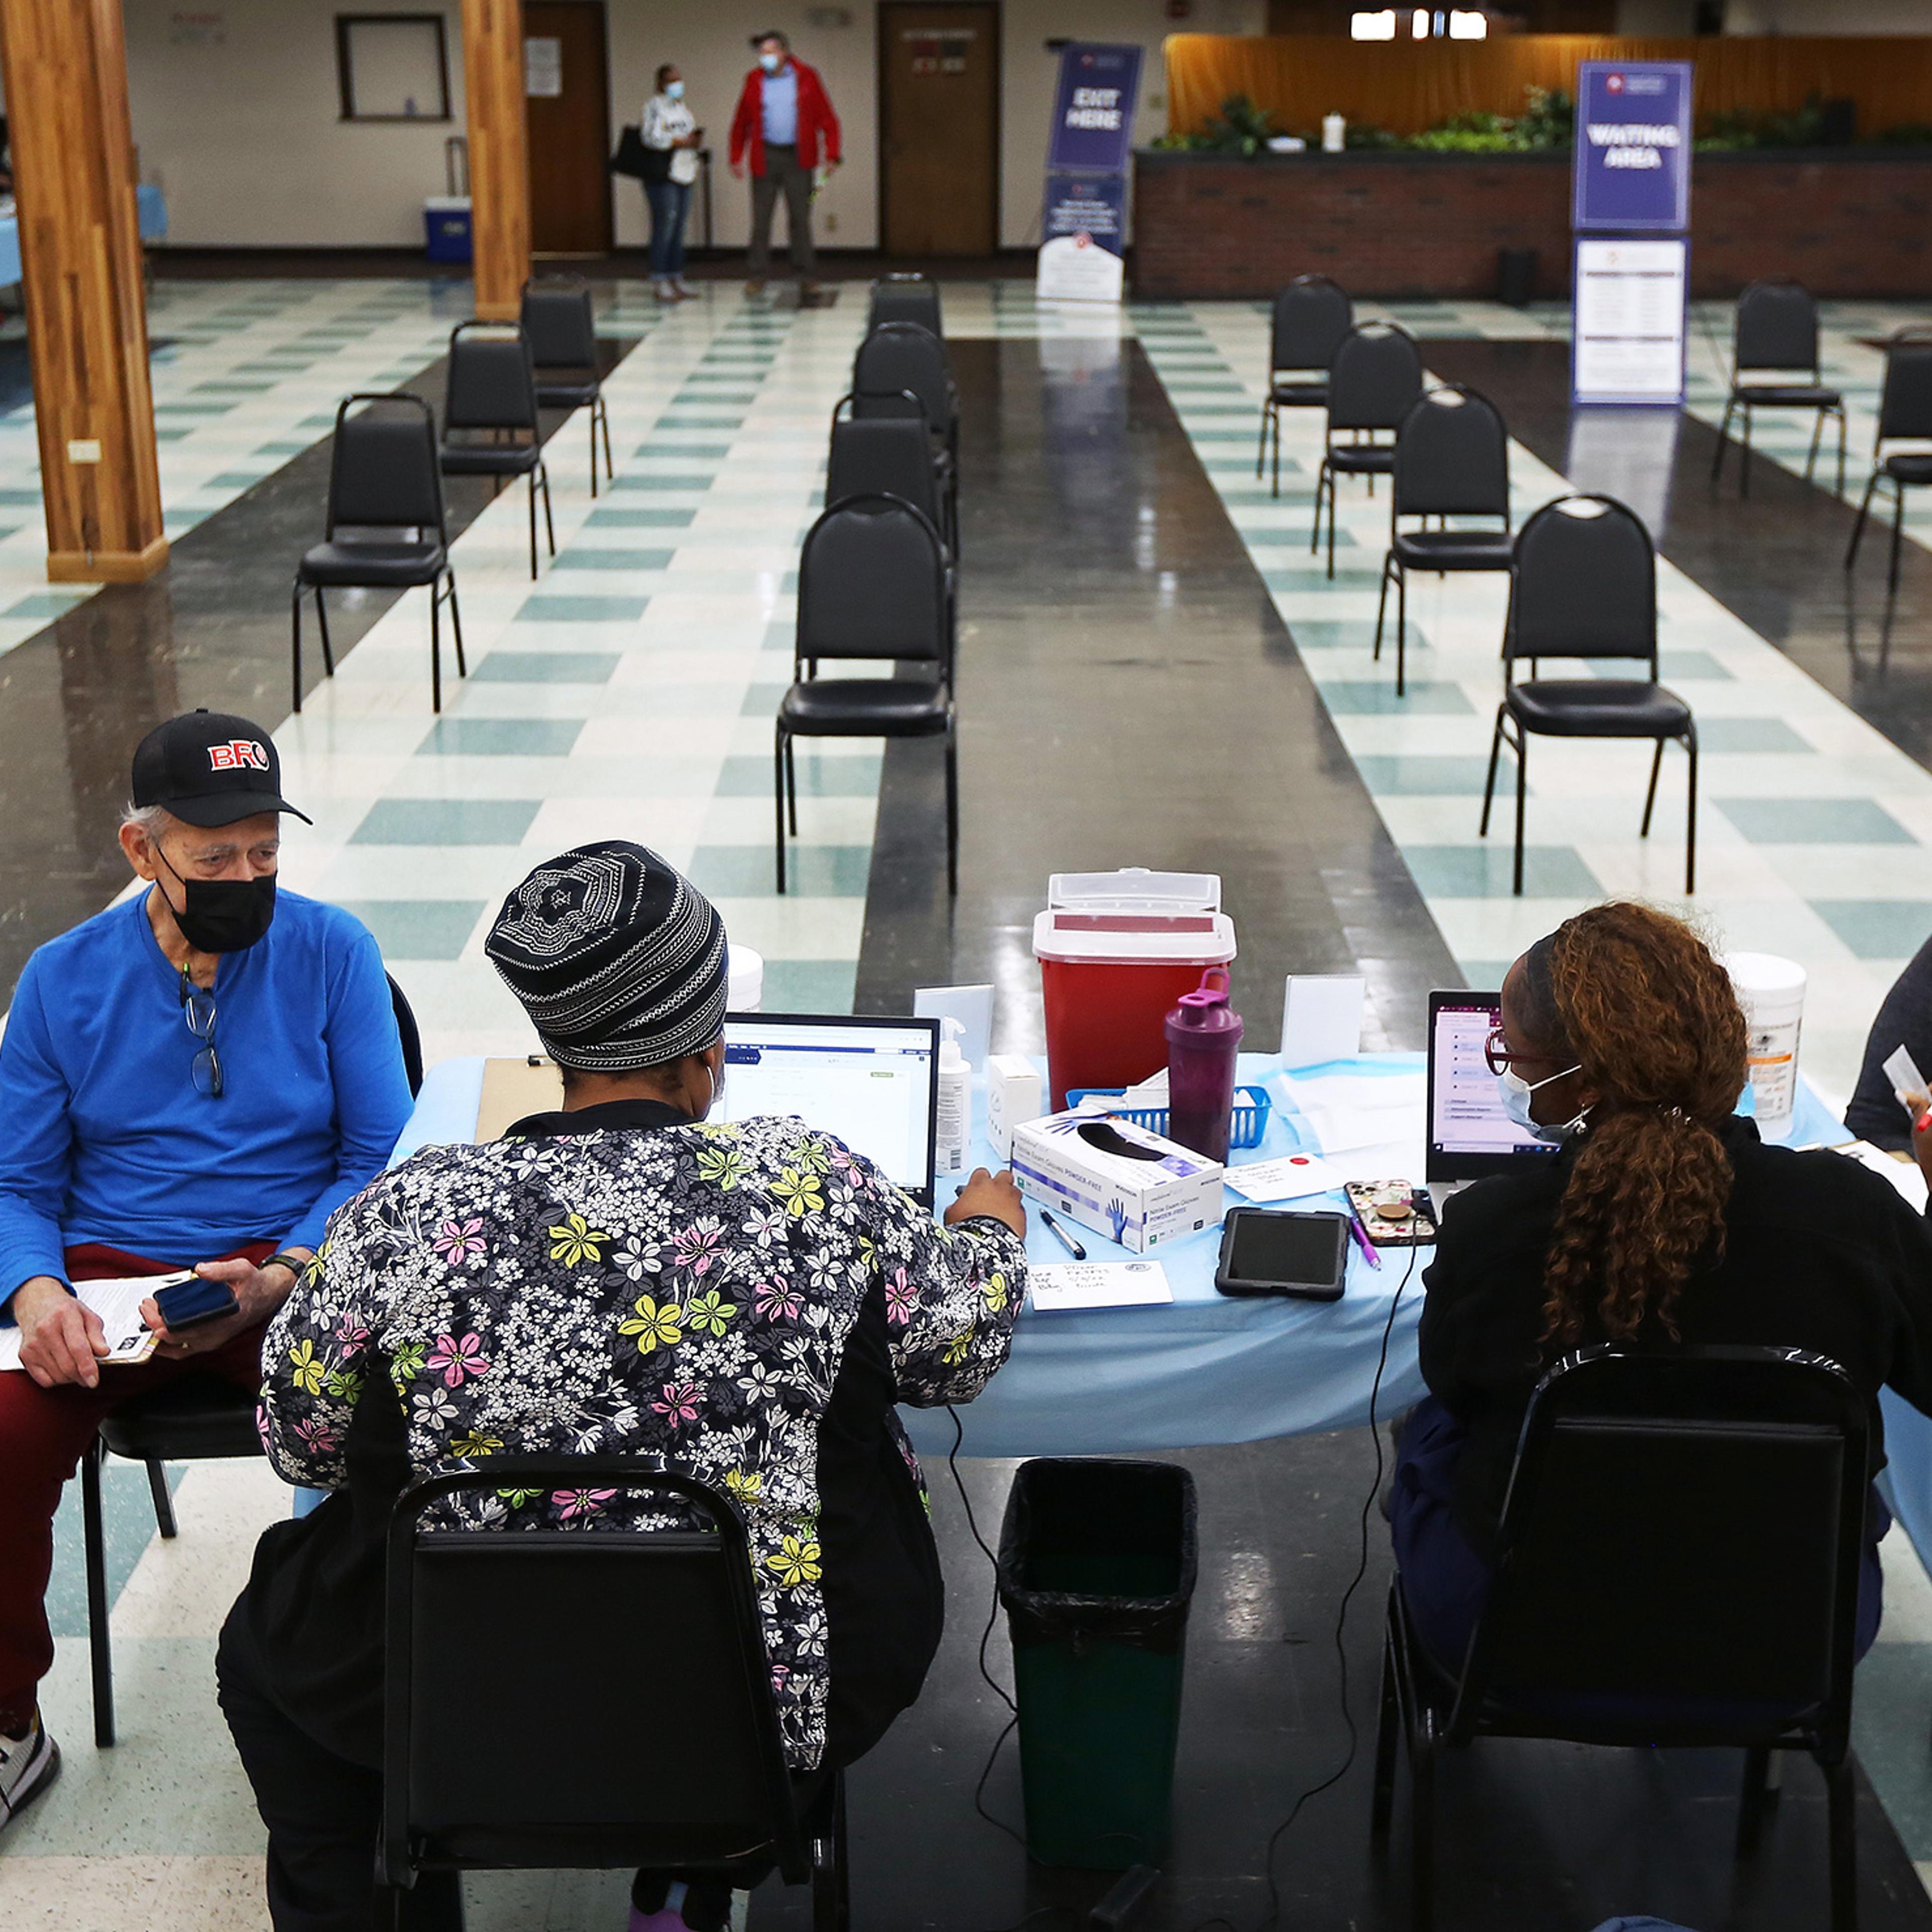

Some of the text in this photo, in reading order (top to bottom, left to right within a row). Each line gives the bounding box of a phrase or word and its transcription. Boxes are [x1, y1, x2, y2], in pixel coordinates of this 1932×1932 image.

[1073, 87, 1122, 108] EXIT
[1586, 123, 1681, 148] WAITING
[1603, 146, 1662, 170] AREA
